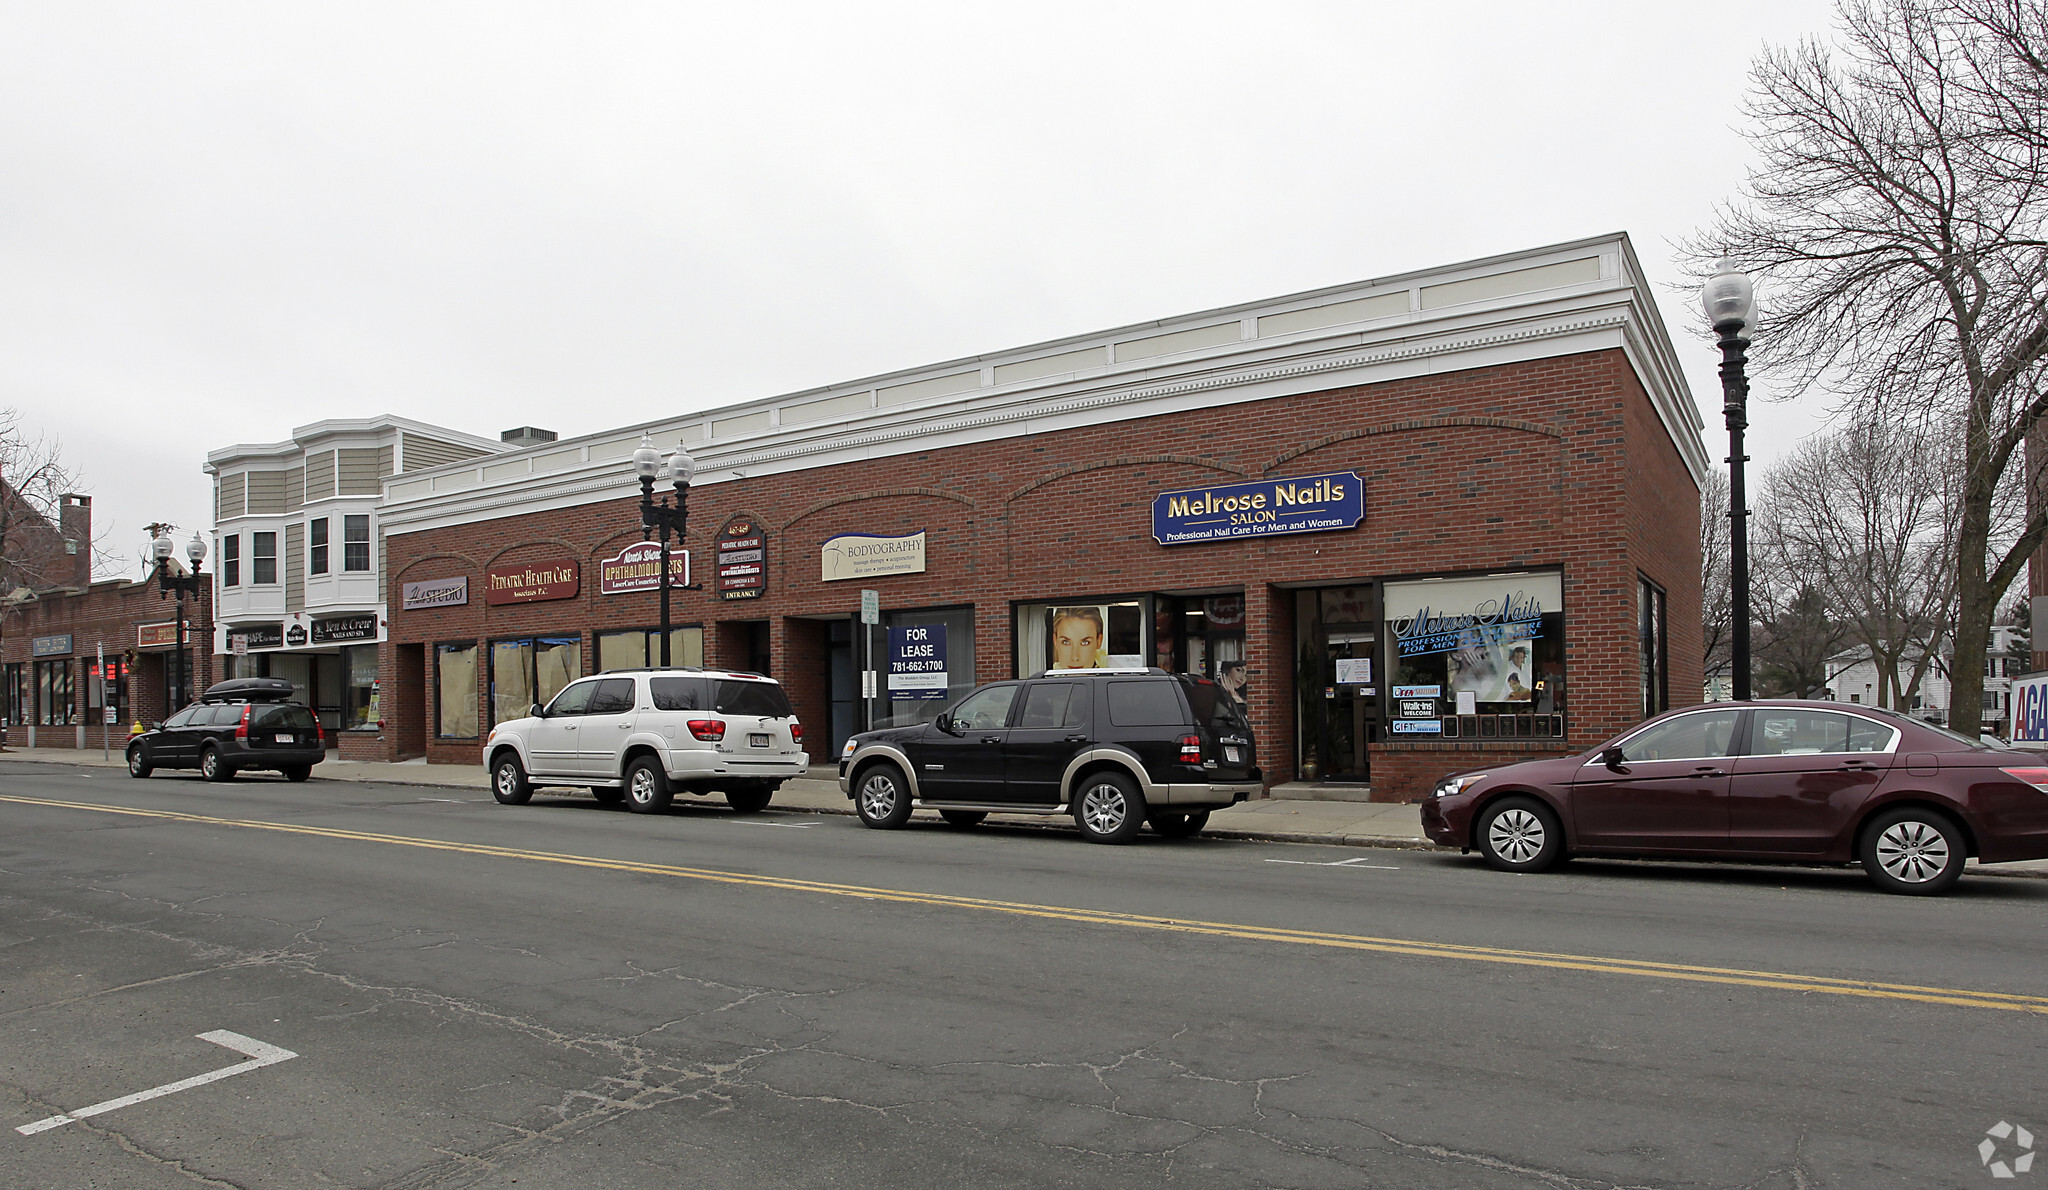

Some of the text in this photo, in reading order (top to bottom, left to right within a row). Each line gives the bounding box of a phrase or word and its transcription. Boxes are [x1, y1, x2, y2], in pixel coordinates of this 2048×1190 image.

[1167, 478, 1345, 518] Melrose Nails
[1230, 510, 1276, 526] SALON
[1166, 518, 1343, 541] Professional Nail Care For Men and Women
[624, 548, 661, 564] North Shor
[848, 540, 922, 557] BODYOGRAPHY
[605, 559, 683, 581] OPHTHALMOLOSTS
[877, 564, 894, 572] personal
[491, 566, 572, 590] PEDIATRIC HEALTH CARE
[426, 586, 463, 603] STUDIO
[726, 590, 756, 599] ENTRANCE
[1391, 590, 1543, 639] Melrose Nails
[325, 619, 372, 632] Yen & Crew
[247, 632, 263, 643] HAPE
[906, 628, 927, 641] FOR
[1398, 632, 1474, 648] PROFESSIONAL
[1513, 621, 1543, 630] CARE
[1405, 645, 1425, 653] FOR
[1432, 641, 1455, 650] MEN
[1493, 629, 1537, 641] WOMEN
[901, 644, 934, 657] LEASE
[892, 660, 943, 672] 781-662-1700
[1395, 687, 1413, 697] OPEN
[1394, 722, 1413, 731] GIFT
